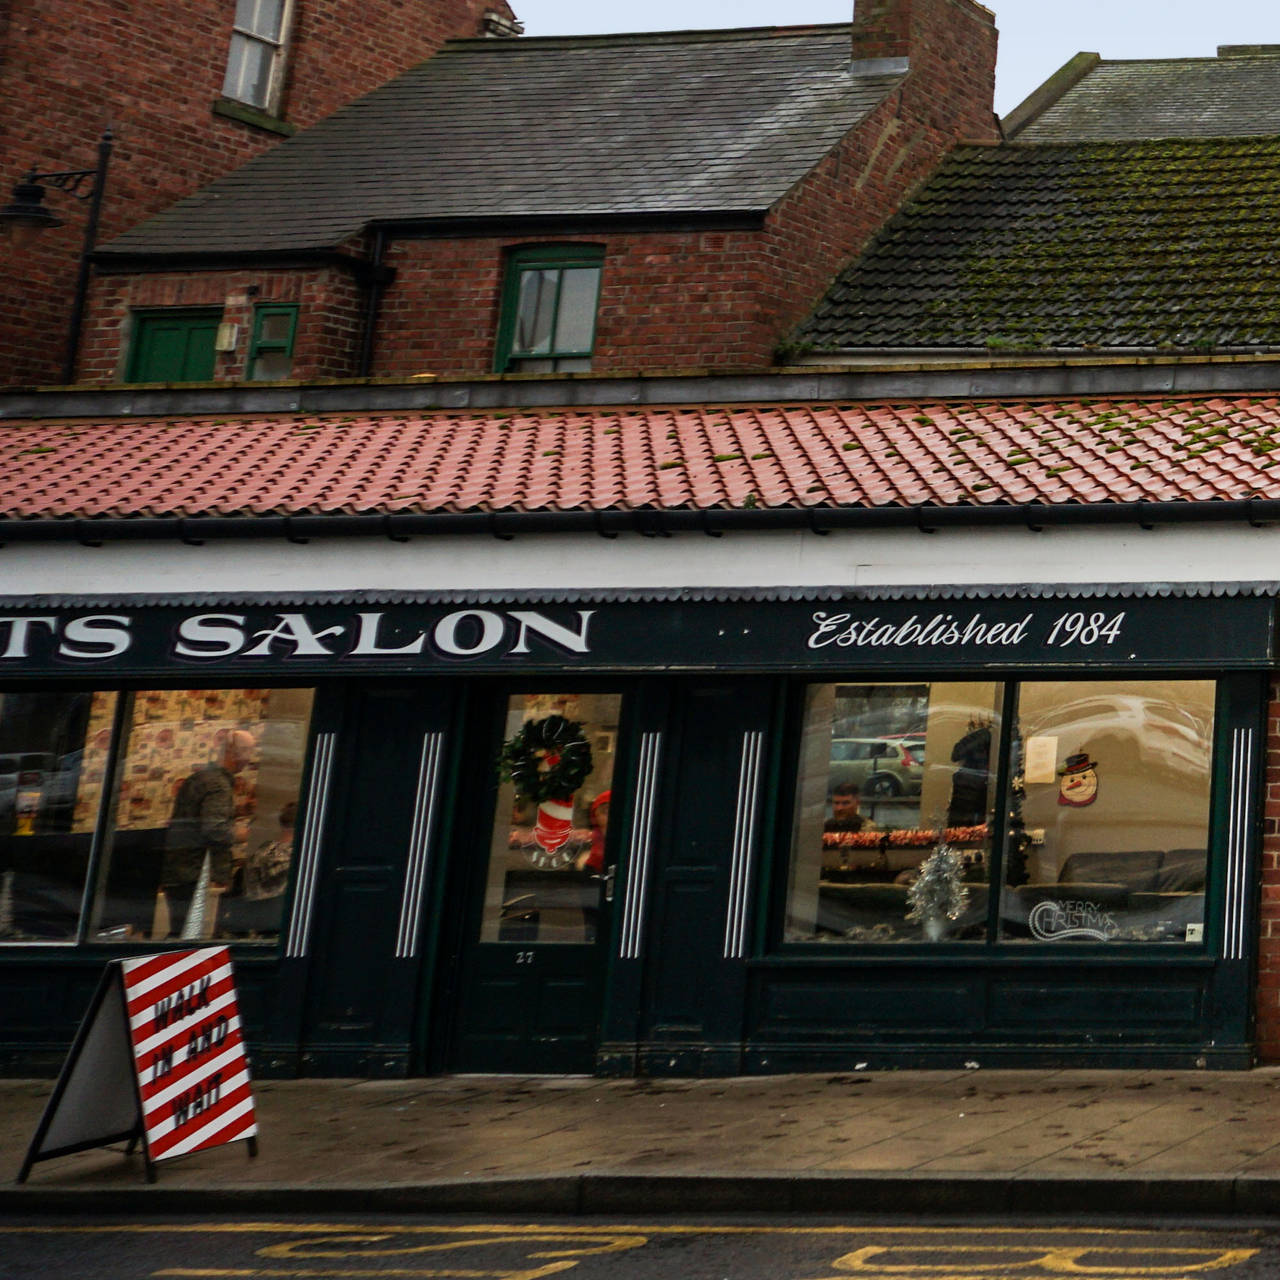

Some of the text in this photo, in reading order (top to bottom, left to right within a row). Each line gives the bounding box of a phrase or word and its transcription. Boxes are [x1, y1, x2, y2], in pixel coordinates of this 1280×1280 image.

[0, 609, 597, 659] TS SALON
[808, 612, 1126, 649] Established 1984
[1058, 900, 1101, 913] MERRY
[516, 951, 535, 964] 27
[153, 974, 212, 1033] WALK
[151, 1015, 230, 1085] IN AND
[172, 1072, 223, 1130] WAIT
